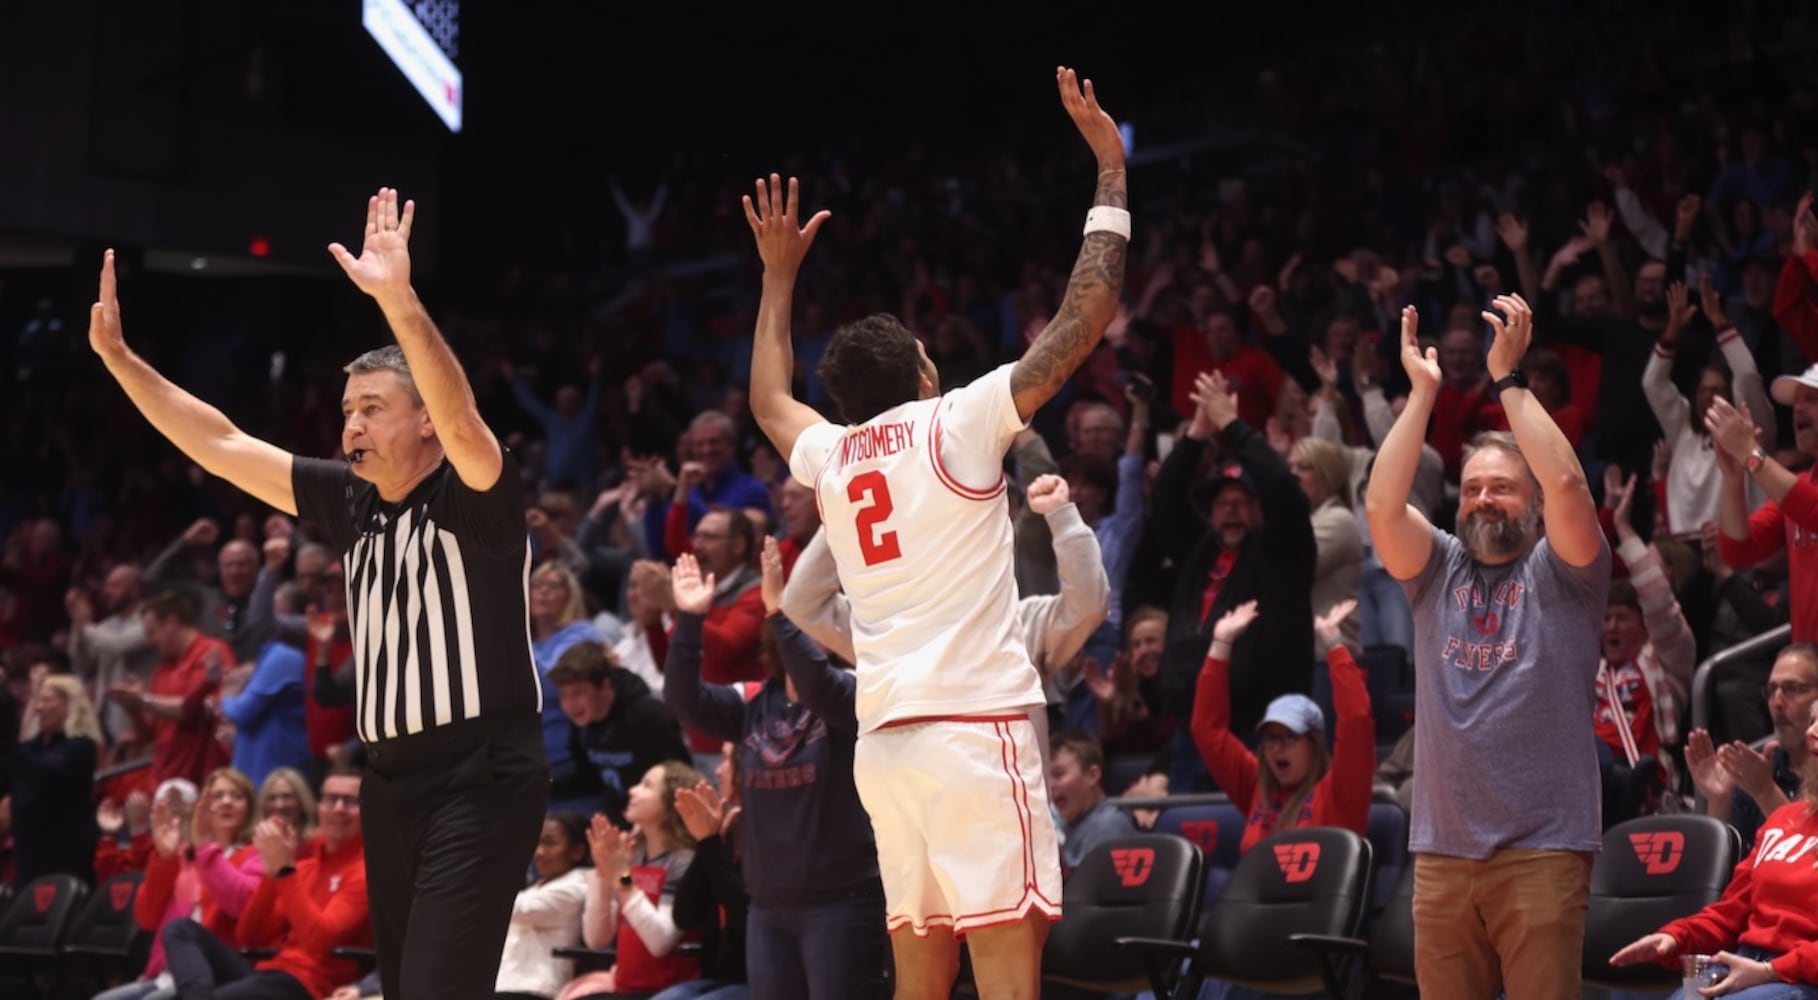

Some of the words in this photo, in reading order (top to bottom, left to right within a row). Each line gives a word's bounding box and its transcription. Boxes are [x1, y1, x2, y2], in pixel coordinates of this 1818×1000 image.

[840, 420, 915, 467] NTGOMERY
[847, 470, 902, 566] 2
[1754, 828, 1818, 869] DAY
